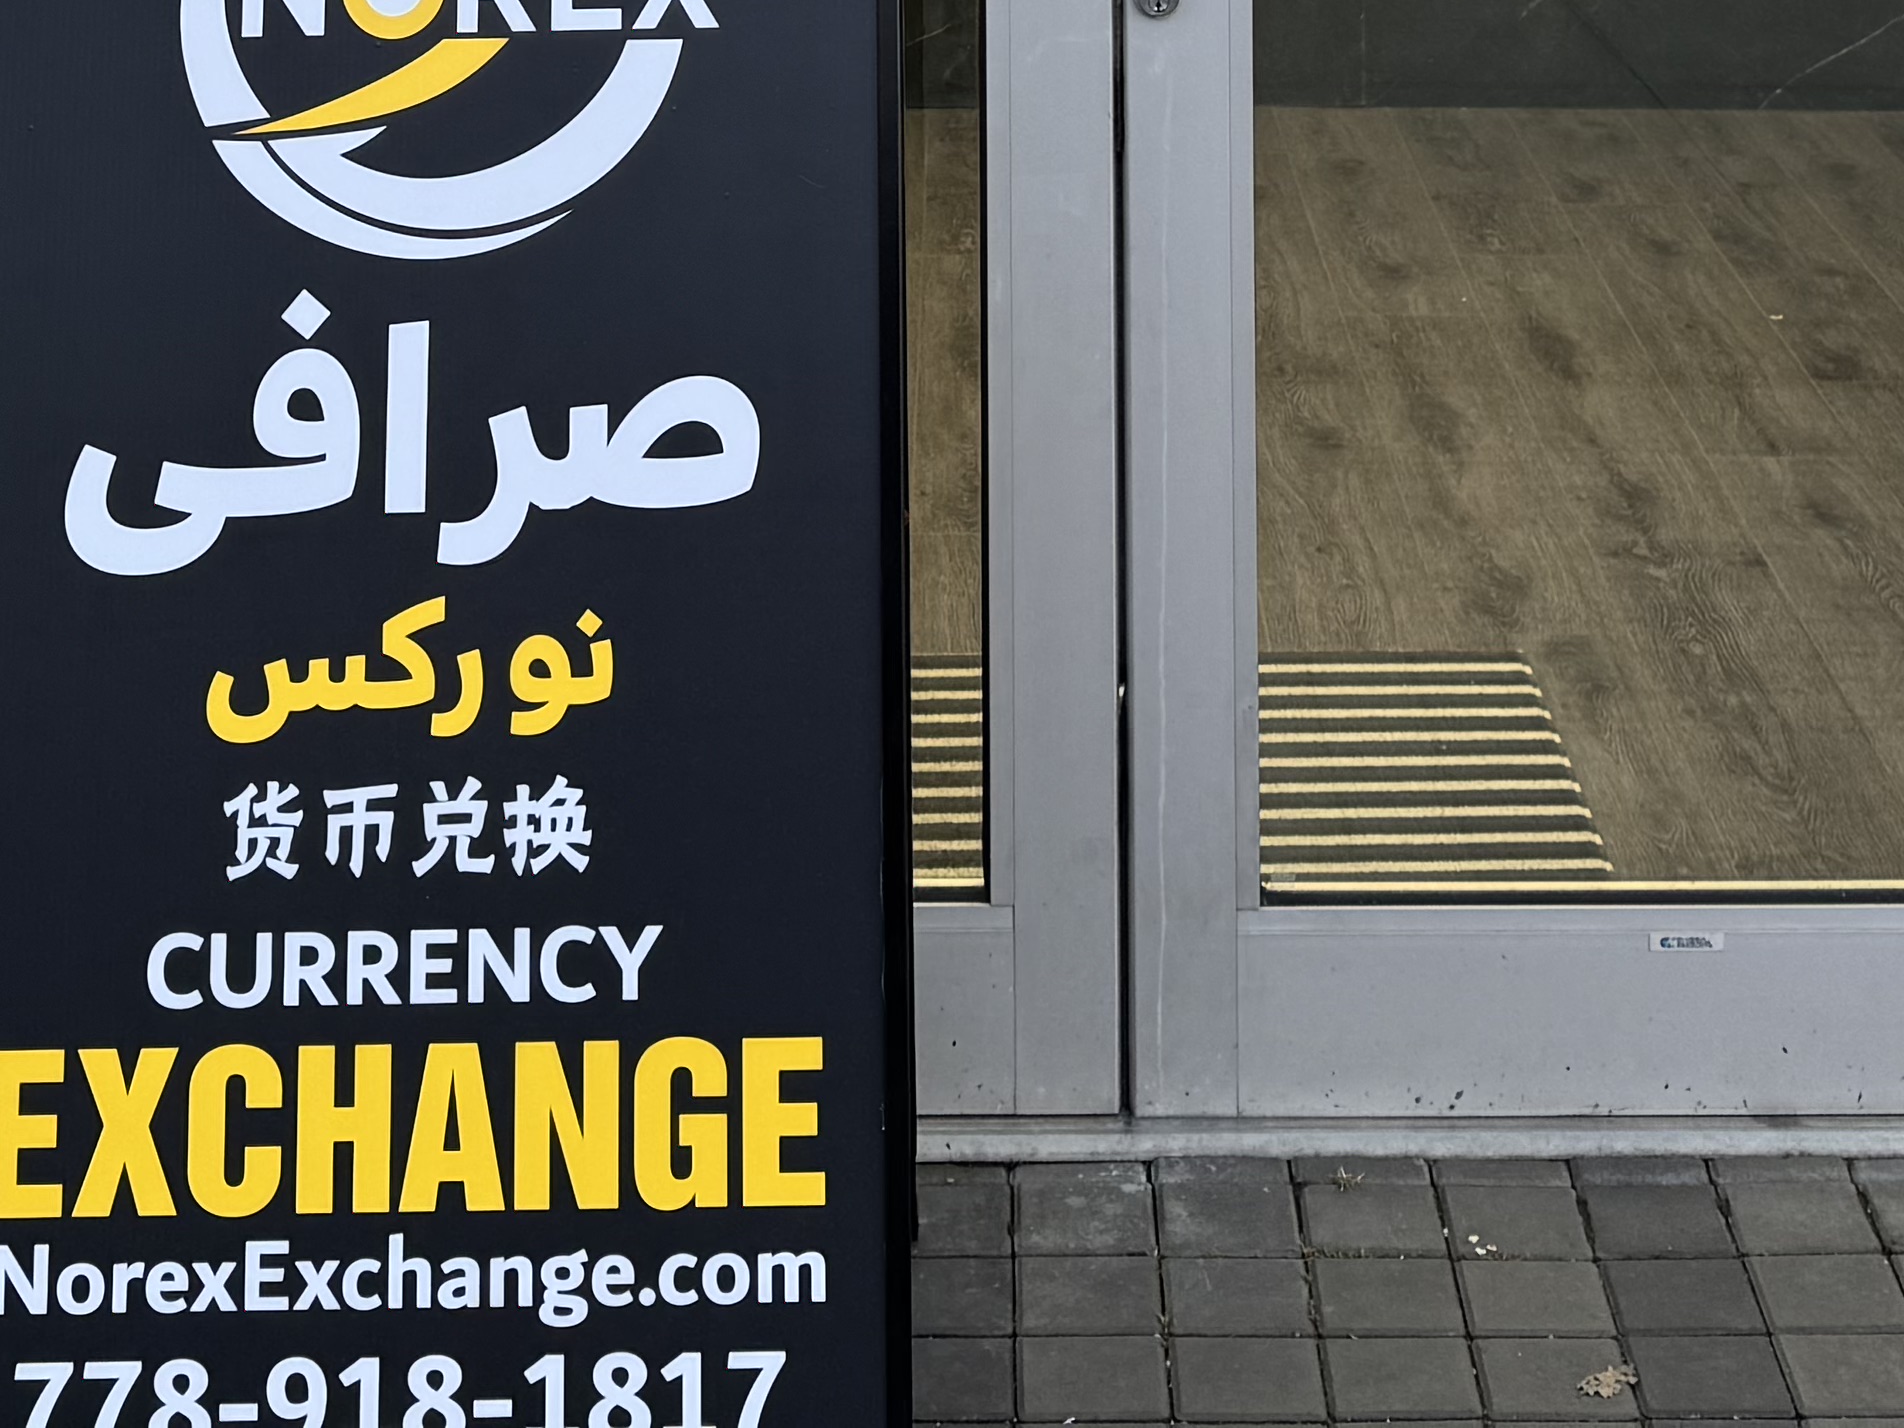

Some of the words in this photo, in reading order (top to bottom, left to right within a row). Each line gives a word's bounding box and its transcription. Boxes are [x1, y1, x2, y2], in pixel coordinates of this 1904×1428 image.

[65, 289, 760, 575] صرافی
[205, 596, 614, 744] نورکس
[224, 775, 592, 881] 货币兑换
[147, 925, 663, 1009] CURRENCY
[12, 1350, 786, 1428] 778-918-1817
